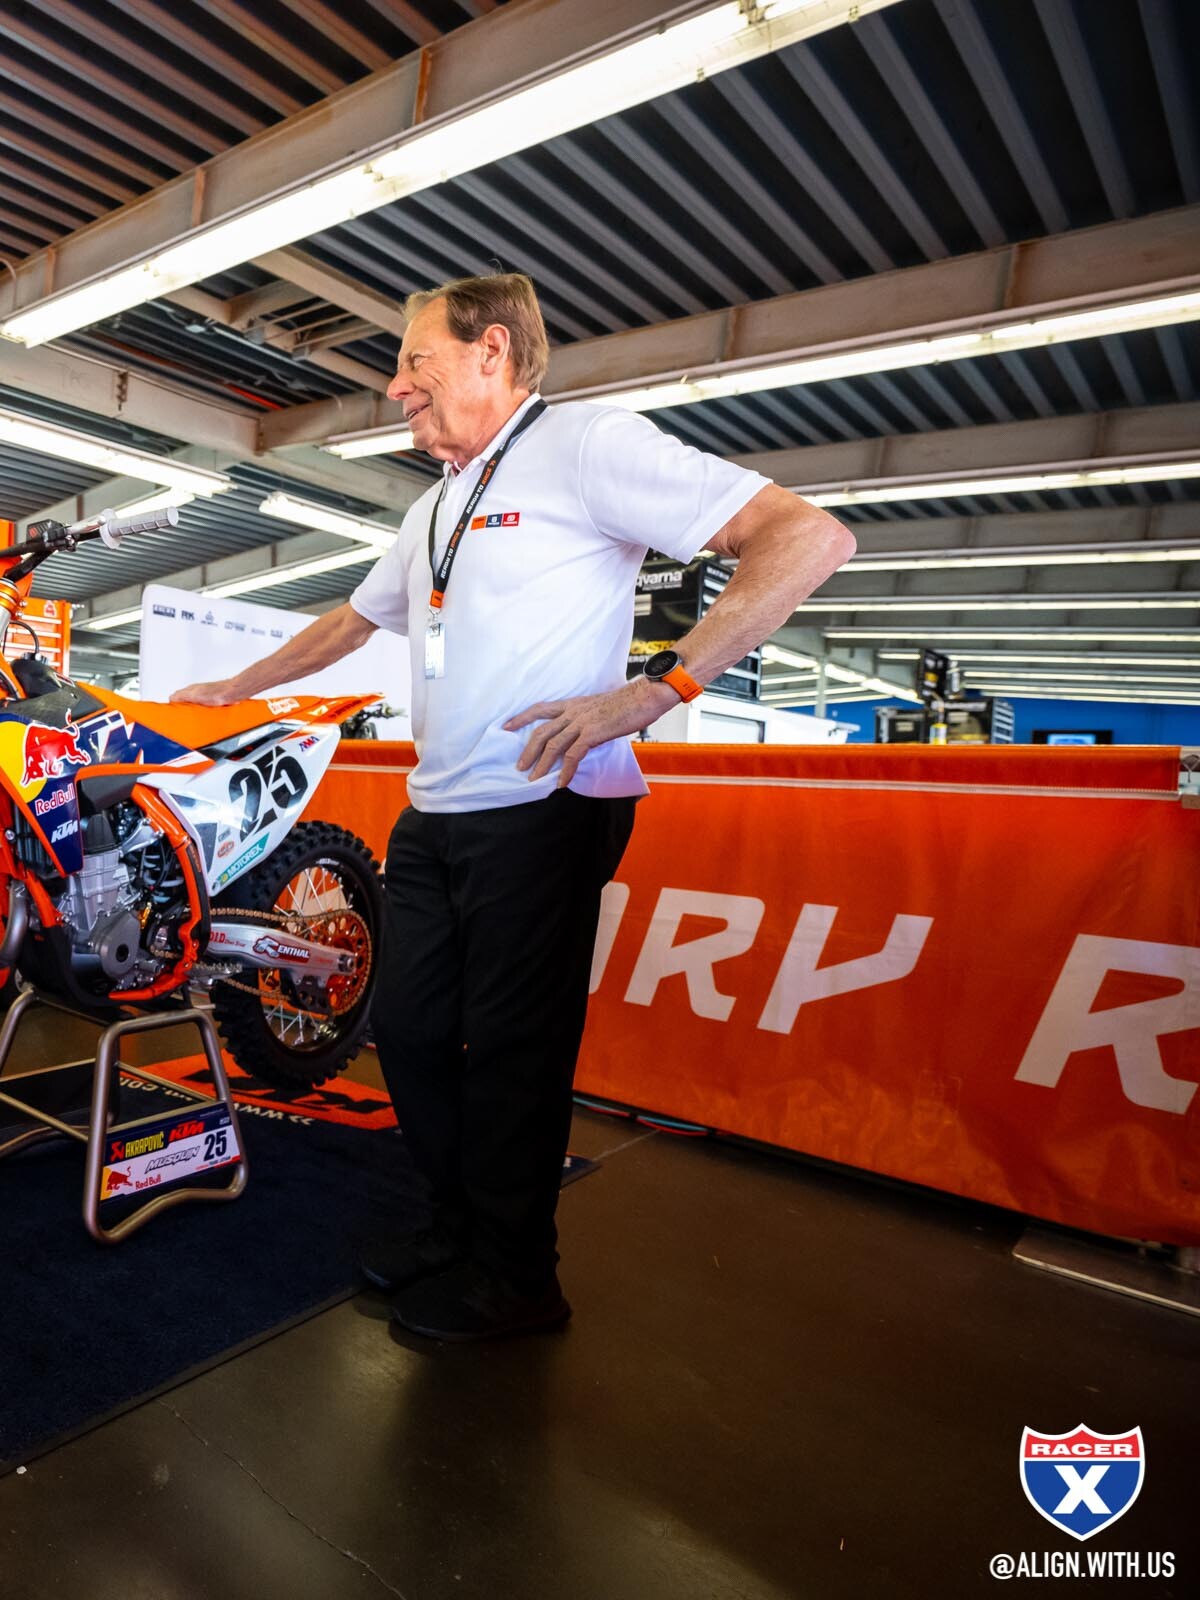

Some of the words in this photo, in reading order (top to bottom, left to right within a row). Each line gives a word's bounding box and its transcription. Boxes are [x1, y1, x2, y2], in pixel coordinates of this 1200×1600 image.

[466, 493, 480, 514] READY
[476, 484, 484, 494] TO
[440, 557, 452, 579] READY
[447, 547, 454, 558] TO
[34, 791, 58, 816] Red
[57, 782, 76, 807] Bull
[228, 745, 309, 843] 25
[51, 819, 79, 844] KTM
[227, 843, 264, 878] MOTOREX
[168, 1120, 205, 1143] KTM
[144, 1146, 201, 1175] MUSQUIN
[203, 1129, 228, 1162] 25
[135, 1178, 149, 1190] Red
[148, 1175, 162, 1187] Bull
